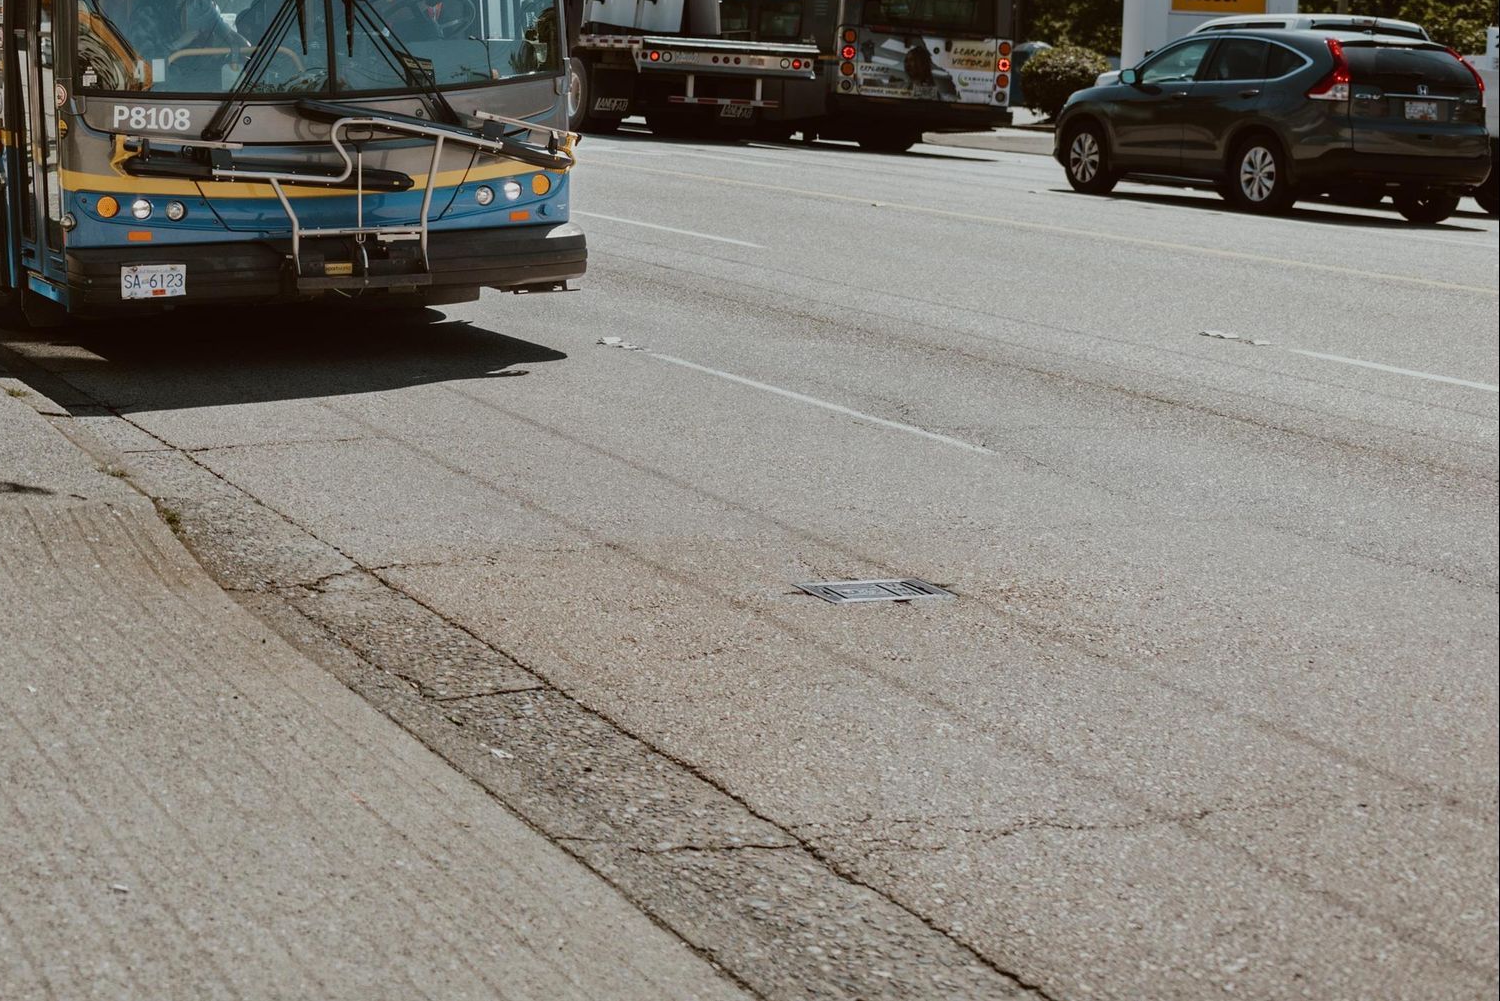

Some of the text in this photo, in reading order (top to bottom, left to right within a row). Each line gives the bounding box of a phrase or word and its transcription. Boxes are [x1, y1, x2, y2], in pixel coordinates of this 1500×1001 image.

[953, 46, 982, 57] LEARN
[952, 57, 992, 68] VICTORIA
[113, 105, 192, 132] P8108
[123, 272, 184, 289] SA 6123
